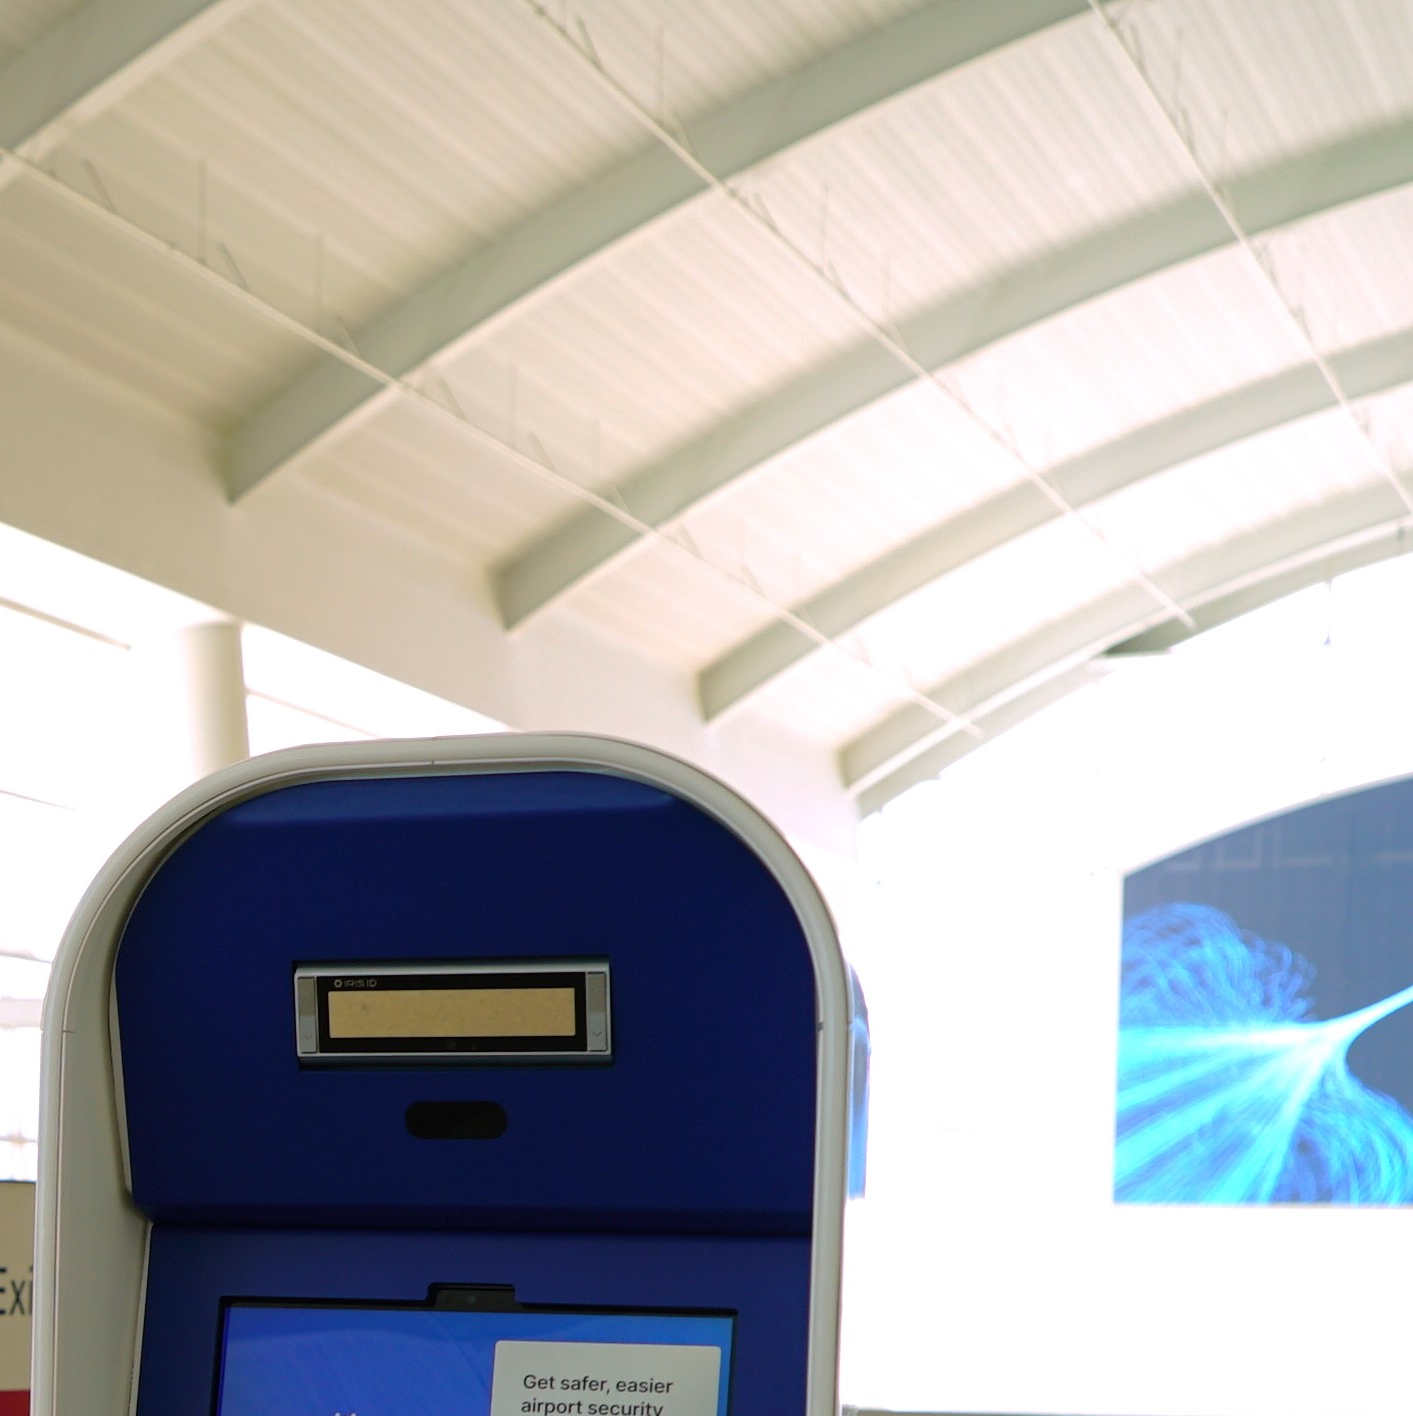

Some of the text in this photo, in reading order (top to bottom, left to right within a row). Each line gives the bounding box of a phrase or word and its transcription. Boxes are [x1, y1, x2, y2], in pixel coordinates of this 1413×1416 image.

[523, 1375, 673, 1395] Get safer, easier
